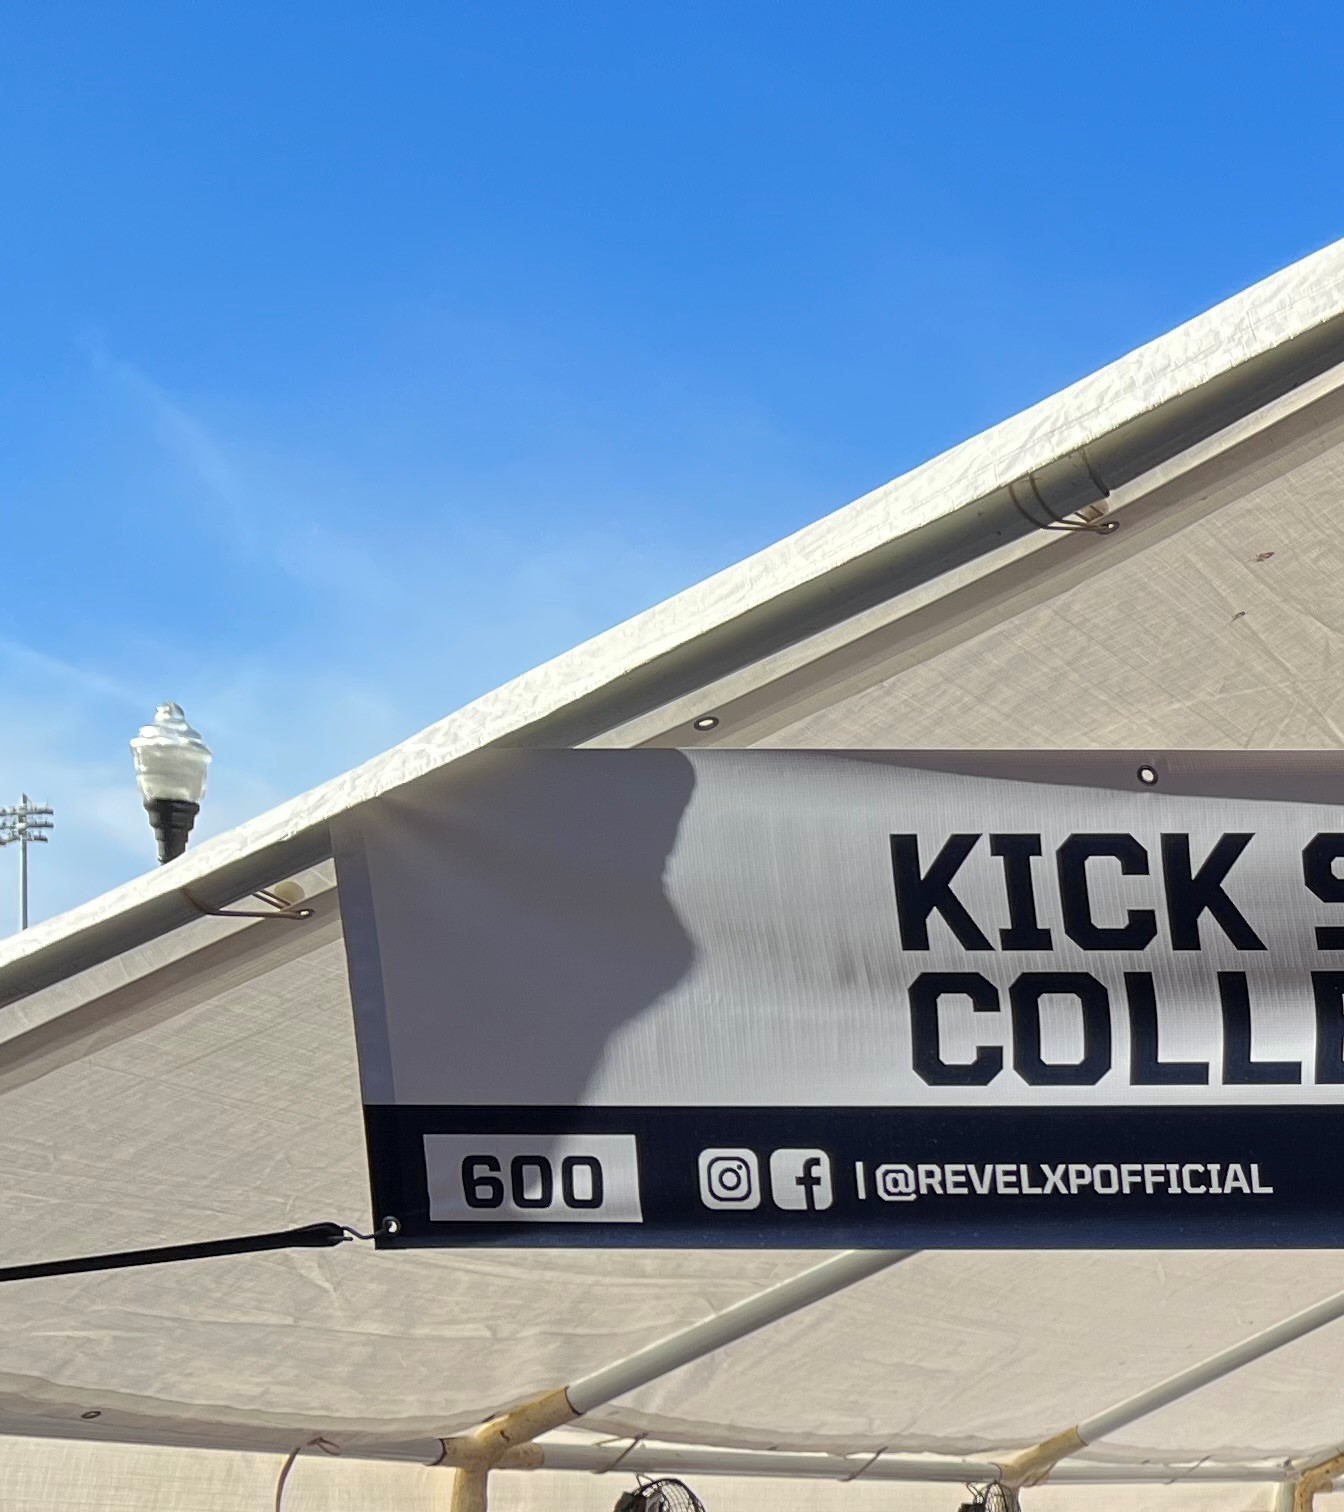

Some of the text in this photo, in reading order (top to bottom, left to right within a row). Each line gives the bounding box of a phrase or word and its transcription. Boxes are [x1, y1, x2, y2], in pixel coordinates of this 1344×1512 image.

[890, 831, 1266, 952] KICK
[460, 1153, 1274, 1210] 600 @REVELXPOFFICIAL
